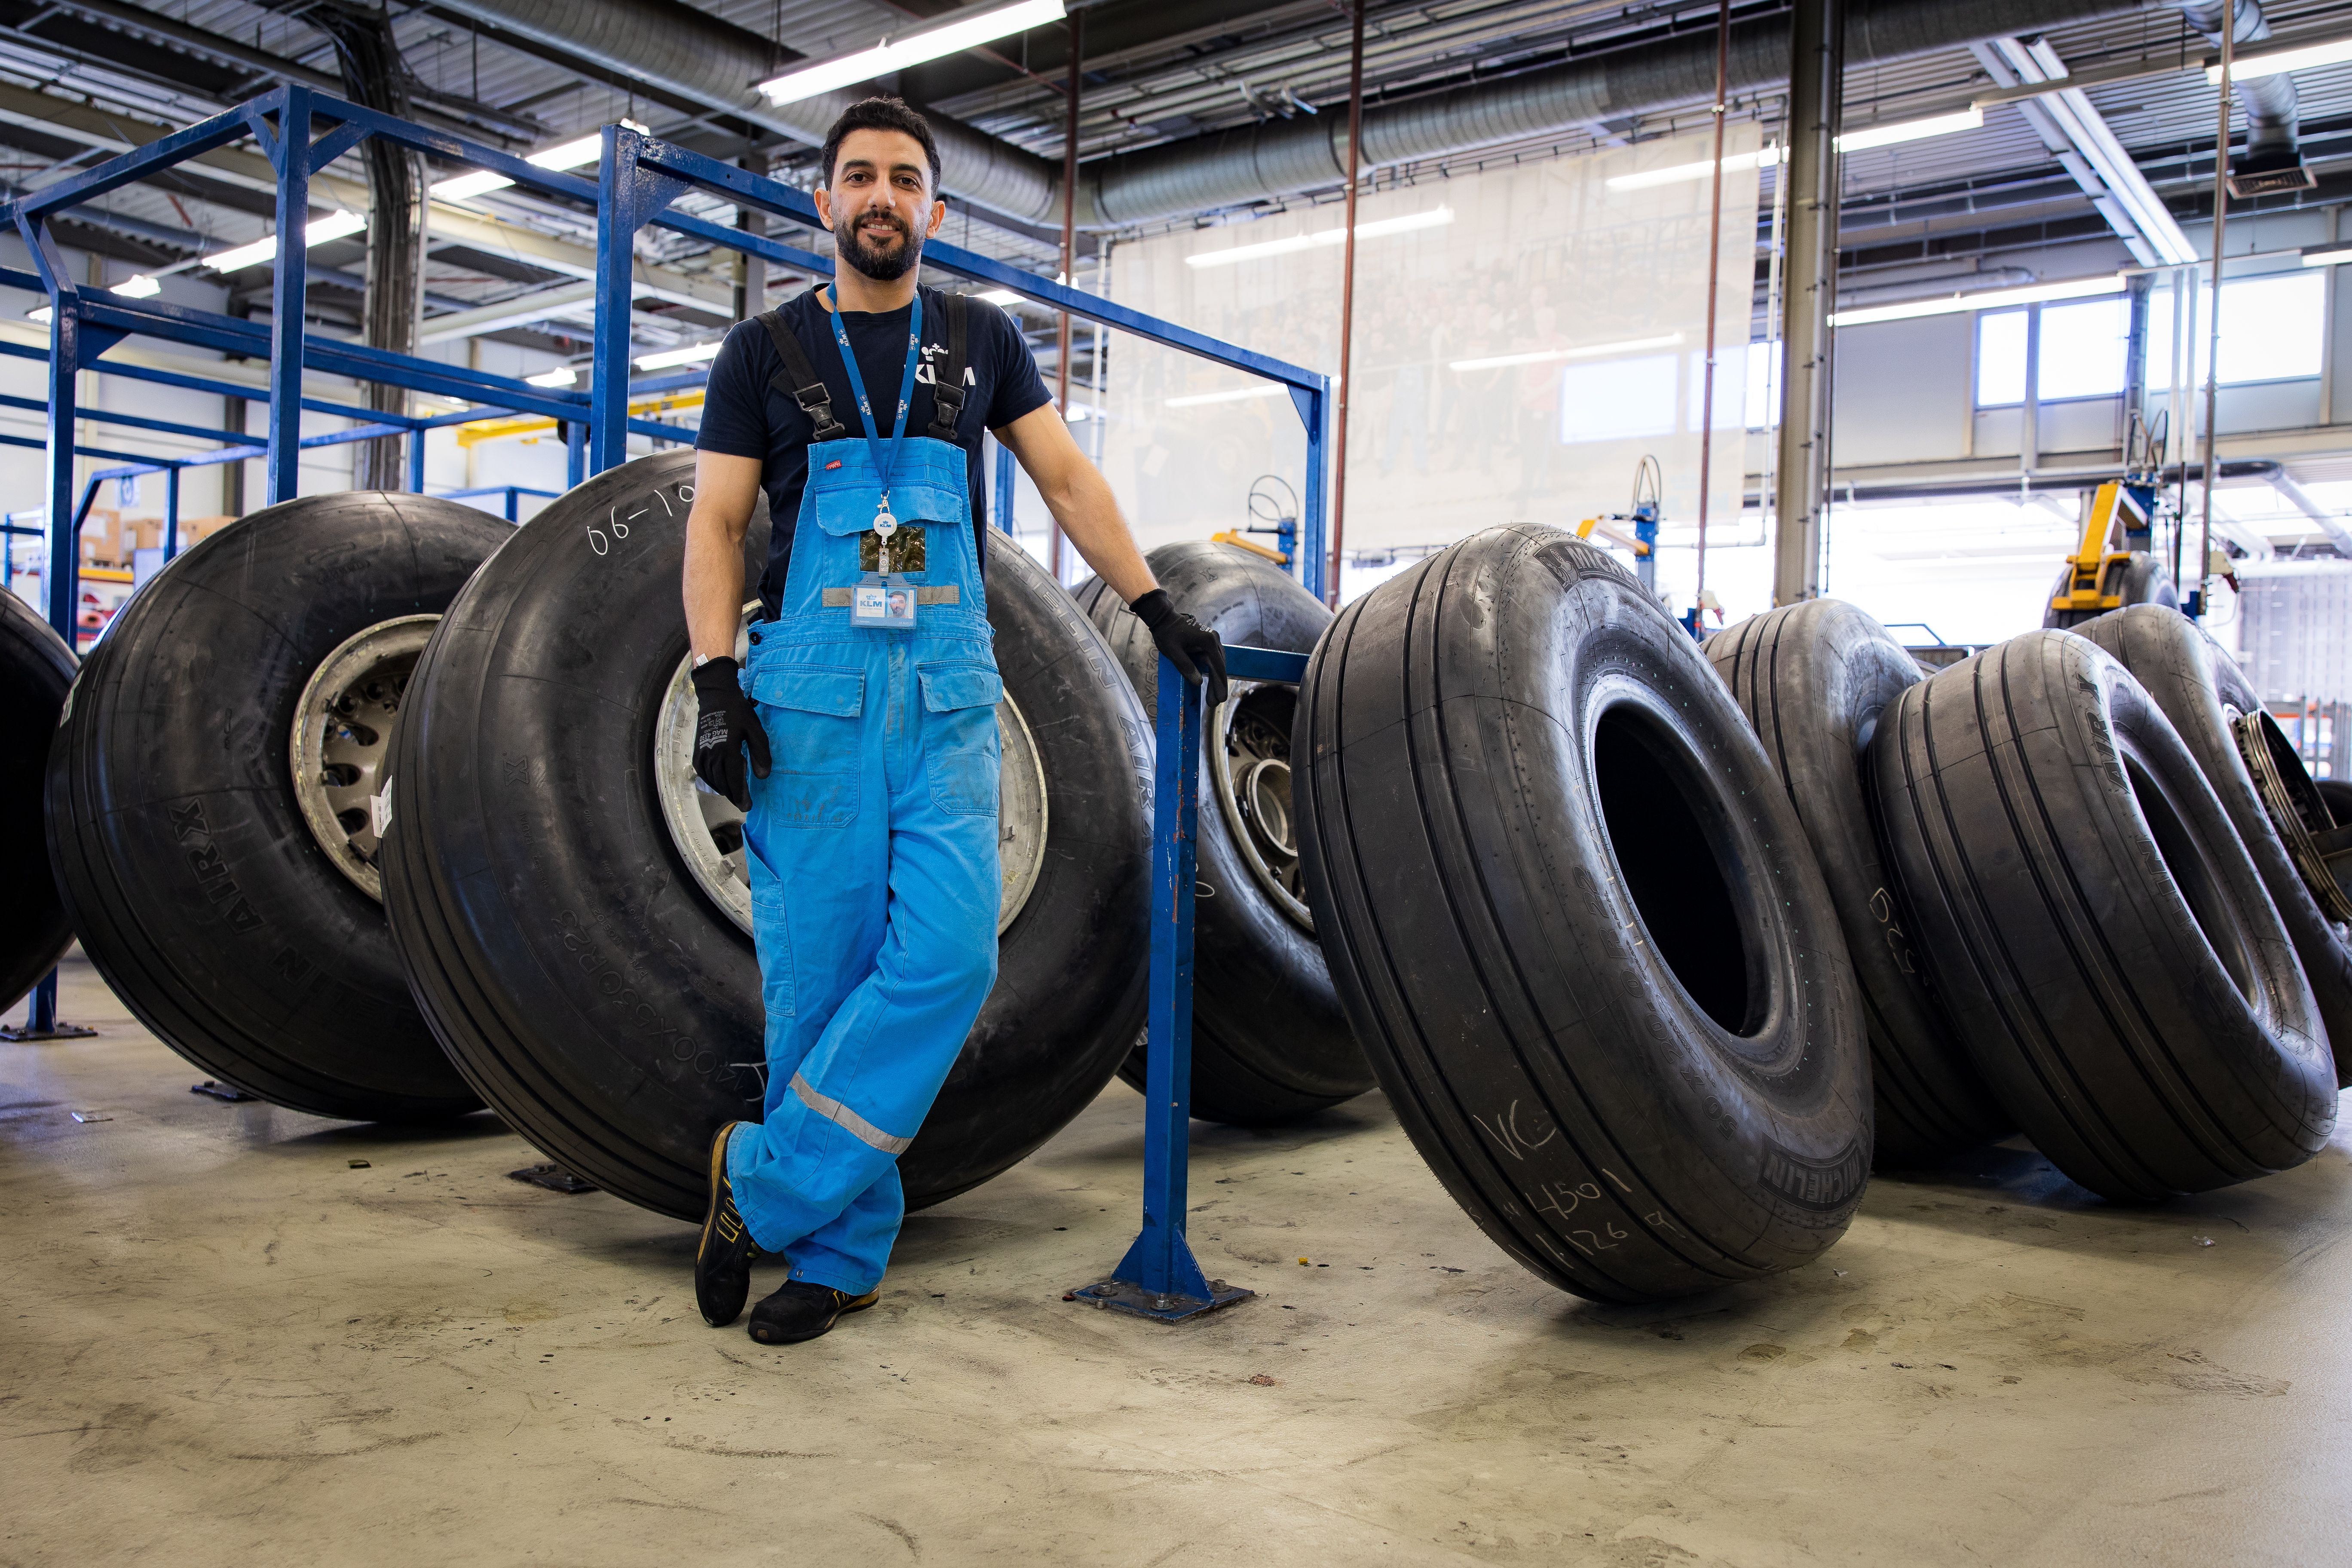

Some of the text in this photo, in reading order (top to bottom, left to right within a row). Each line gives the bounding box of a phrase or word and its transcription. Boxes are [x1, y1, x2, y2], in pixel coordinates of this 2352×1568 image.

[700, 729, 728, 741] MAG 4330
[1701, 1093, 1739, 1141] 50
[1764, 1147, 1861, 1204] MICHELIN
